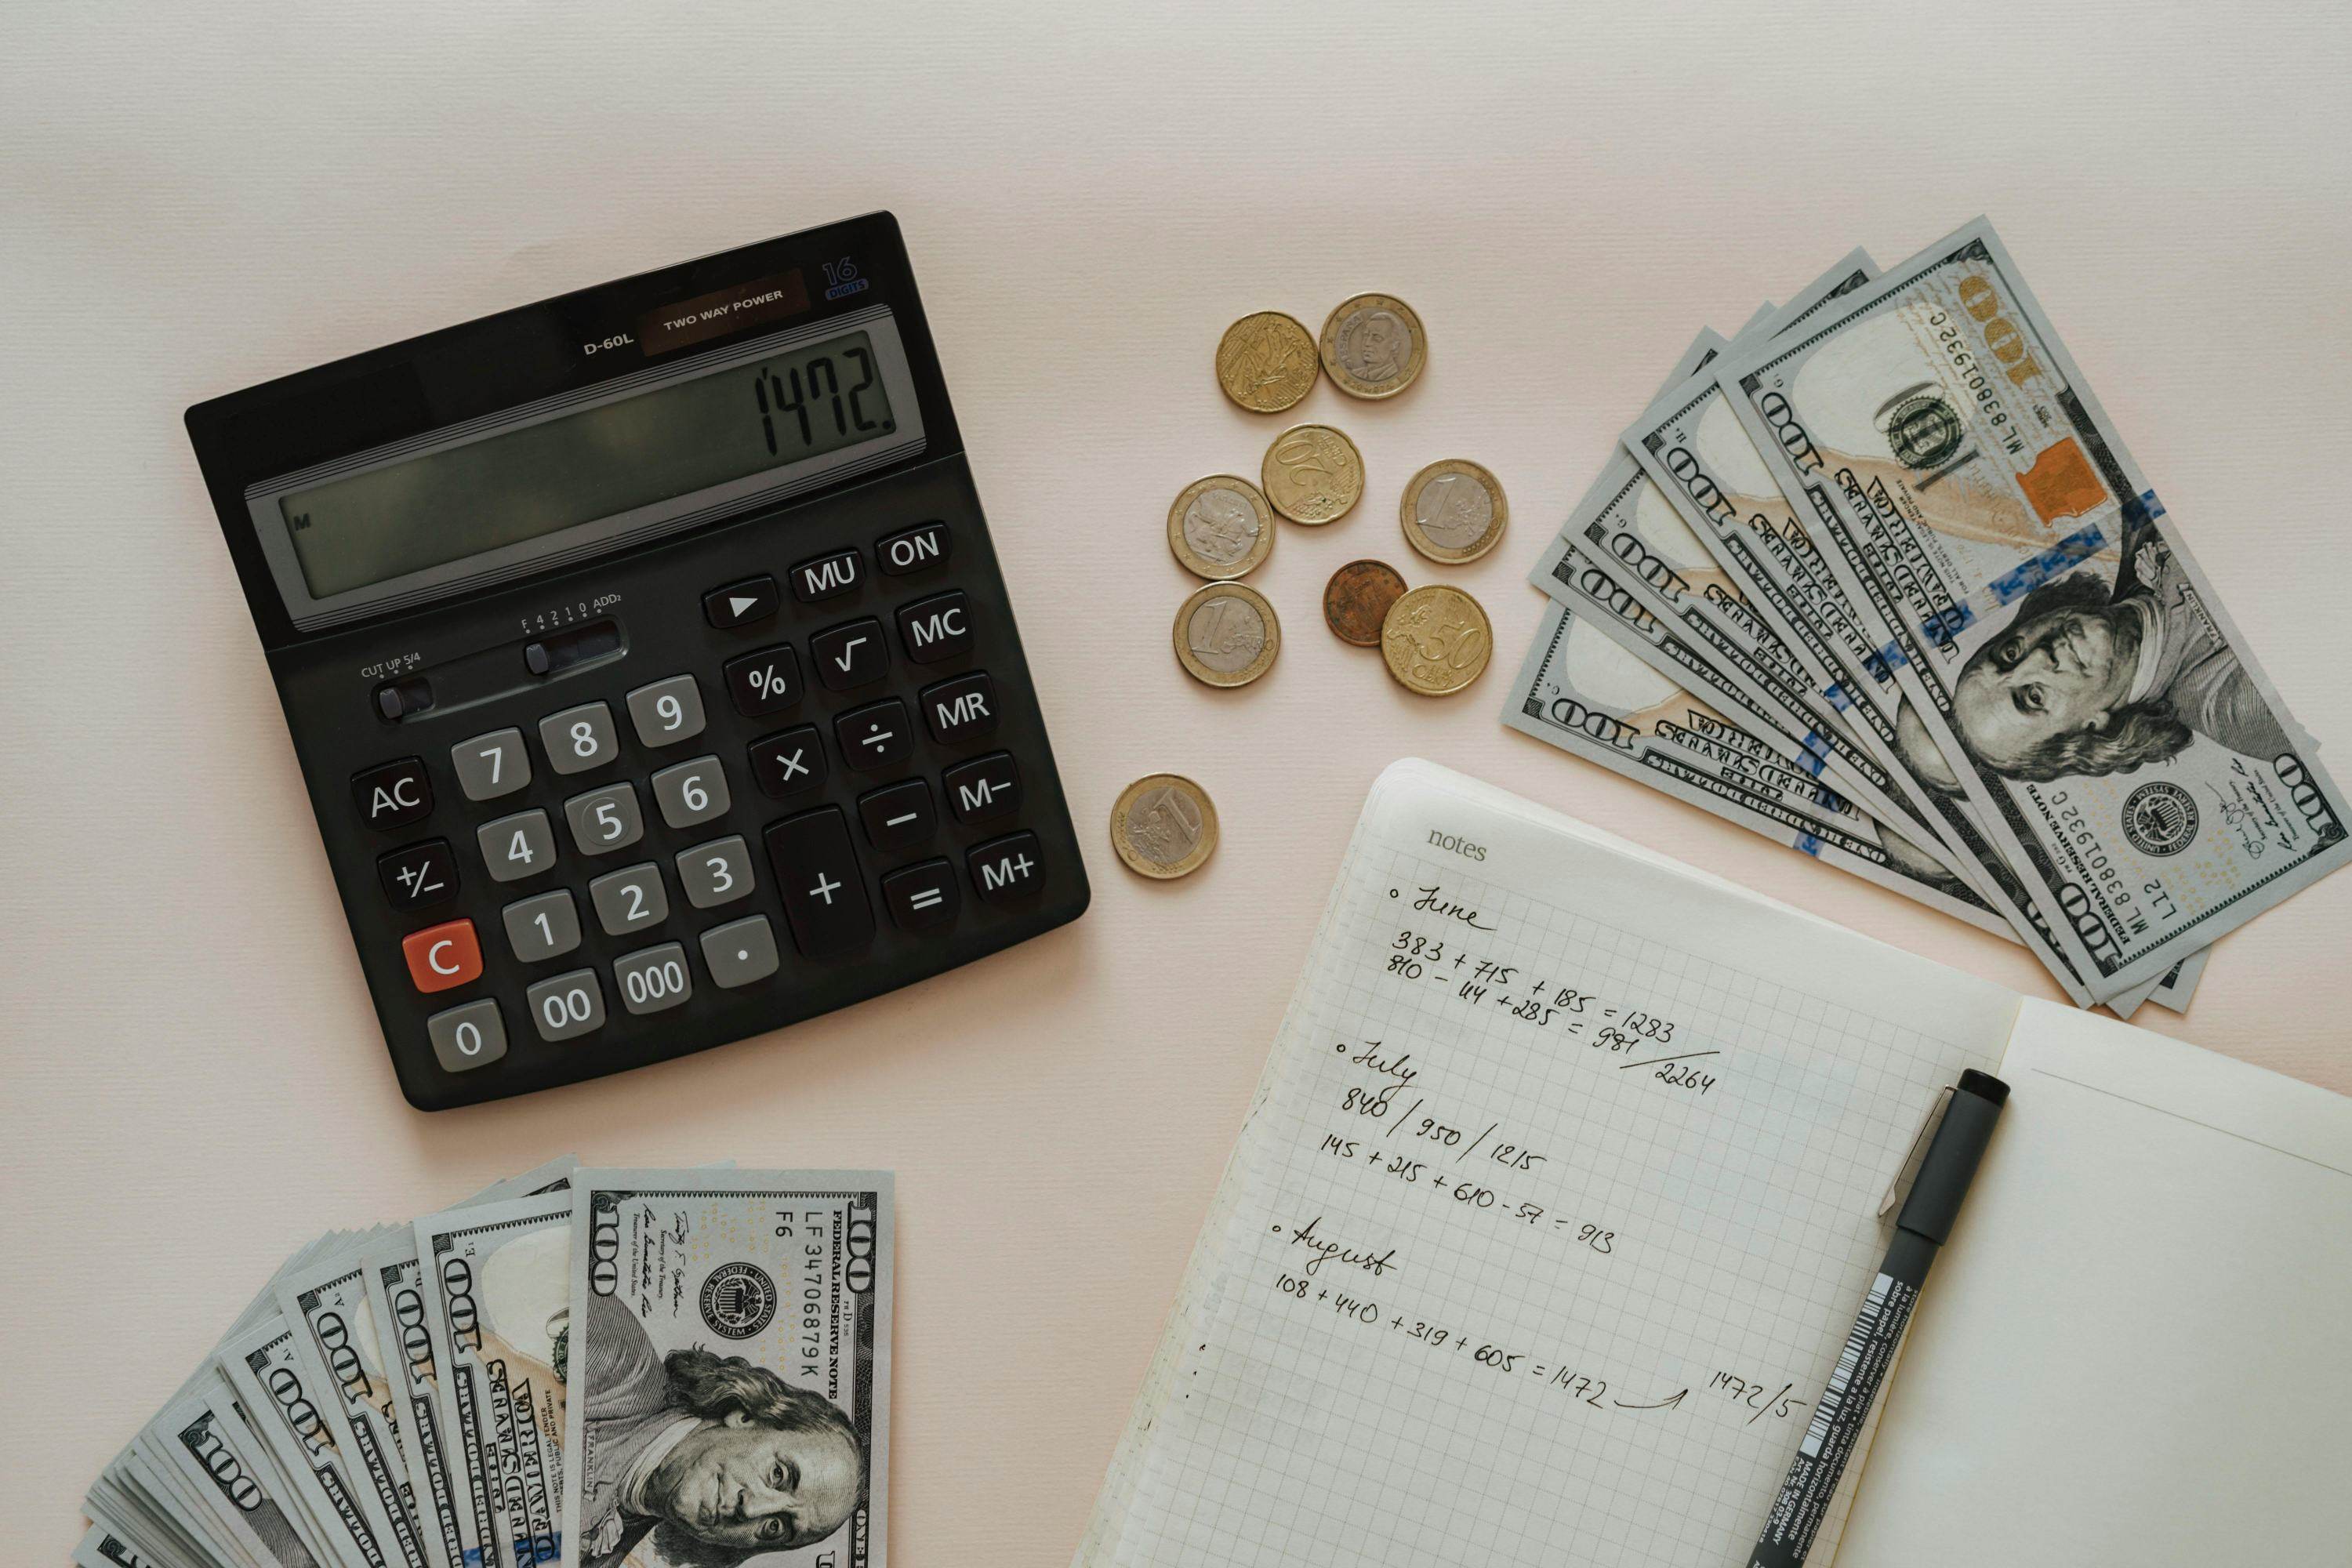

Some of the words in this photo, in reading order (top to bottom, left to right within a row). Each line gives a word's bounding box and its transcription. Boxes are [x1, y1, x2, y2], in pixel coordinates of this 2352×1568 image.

[822, 256, 857, 285] 16
[828, 280, 866, 299] DIGITS
[664, 316, 696, 330] TWO
[700, 306, 728, 320] WAY
[734, 291, 782, 310] POWER
[1928, 310, 1947, 328] C
[584, 334, 633, 354] D-60L
[1958, 275, 2044, 387] 100
[1936, 325, 2009, 427] 83801932
[1761, 391, 1824, 473] 100
[1998, 425, 2025, 455] ML
[1666, 446, 1737, 523] 100
[294, 514, 310, 530] M
[891, 532, 938, 565] ON
[1610, 532, 1692, 601] 100
[805, 557, 855, 593] MU
[521, 619, 528, 628] F
[537, 616, 543, 625] 4
[550, 611, 558, 621] 2
[565, 608, 571, 616] 1
[912, 608, 965, 646] MC
[1864, 579, 1926, 671] HUNDRED
[2185, 592, 2218, 639] FRANKLIN
[361, 664, 384, 679] CUT
[386, 659, 401, 670] UP
[403, 652, 421, 665] 5/4
[750, 665, 785, 699] %
[1920, 671, 1951, 712] ONE
[656, 695, 683, 731] 9
[937, 693, 989, 728] MR
[1551, 696, 1641, 749] 100
[570, 722, 598, 757] 8
[480, 747, 502, 784] 7
[372, 778, 419, 818] AC
[682, 776, 709, 811] 6
[2025, 782, 2055, 823] NOTE
[2050, 789, 2069, 806] C
[2273, 753, 2337, 835] 100
[596, 804, 622, 840] 5
[508, 830, 532, 864] 4
[1428, 830, 1486, 861] notes
[2049, 819, 2093, 884] RESERVE
[2060, 804, 2132, 907] 83801932
[706, 857, 733, 892] 3
[982, 854, 1033, 890] M+
[620, 885, 650, 921] 2
[1414, 887, 1497, 931] June
[2089, 883, 2131, 945] FEDERAL
[2142, 877, 2176, 920] L12
[534, 913, 554, 946] 1
[2059, 880, 2124, 964] 100
[2122, 906, 2150, 936] ML
[429, 940, 459, 975] C
[627, 961, 683, 1003] 000
[1391, 931, 1443, 965] 383
[1455, 954, 1465, 968] +
[1475, 961, 1518, 983] 715
[1534, 981, 1544, 995] +
[1555, 989, 1595, 1012] 185
[1618, 1012, 1674, 1046] 1283
[543, 989, 590, 1029] 00
[1512, 996, 1564, 1025] 285
[456, 1022, 481, 1055] 0
[1353, 1041, 1418, 1103] July
[1656, 1063, 1715, 1094] 2264
[1341, 1088, 1388, 1117] 840
[1417, 1119, 1461, 1145] 950
[1491, 1145, 1546, 1169] 1215
[1321, 1134, 1359, 1157] 145
[1370, 1152, 1382, 1164] +
[1388, 1157, 1426, 1181] 215
[1434, 1176, 1446, 1188] +
[1454, 1184, 1494, 1207] 610
[1515, 1203, 1544, 1224] 57
[1578, 1225, 1614, 1253] 913
[775, 1211, 793, 1237] F6
[804, 1211, 822, 1236] LF
[591, 1205, 619, 1297] 100
[831, 1210, 841, 1279] FEDERAL
[845, 1200, 872, 1294] 100
[1292, 1218, 1396, 1276] August
[443, 1258, 483, 1350] 100
[802, 1244, 822, 1358] 34706879
[1887, 1280, 1905, 1308] sobre
[1900, 1293, 1910, 1303] la
[394, 1289, 440, 1381] 100
[829, 1282, 840, 1354] RESERVE
[1872, 1308, 1893, 1338] papel,
[1883, 1303, 1905, 1341] lumière,
[317, 1311, 373, 1401] 100
[1276, 1274, 1308, 1298] 108
[1319, 1290, 1327, 1300] +
[1336, 1294, 1377, 1322] 440
[1392, 1317, 1402, 1329] +
[1407, 1323, 1448, 1345] 319
[1457, 1338, 1466, 1350] +
[1475, 1345, 1524, 1371] 605
[1552, 1367, 1606, 1407] 1472
[801, 1366, 818, 1377] K
[828, 1357, 838, 1399] NOTE
[1853, 1339, 1879, 1386] resistente
[1865, 1342, 1888, 1385] conserver
[269, 1367, 336, 1453] 100
[1836, 1405, 1851, 1425] luz,
[1845, 1395, 1856, 1405] la
[1852, 1394, 1866, 1414] plat
[539, 1406, 551, 1436] TENDER
[1840, 1422, 1854, 1445] tinta
[544, 1439, 556, 1464] LEGAL
[1820, 1424, 1843, 1460] guarda
[188, 1432, 262, 1514] 100
[586, 1435, 594, 1488] FRANKLIN
[1794, 1457, 1806, 1475] Art.
[1795, 1461, 1813, 1488] MADE
[1816, 1445, 1845, 1501] documento,
[550, 1475, 560, 1493] NOTE
[1788, 1475, 1798, 1488] Nr.
[1791, 1488, 1801, 1499] IN
[554, 1495, 563, 1512] THIS
[1772, 1504, 1785, 1525] 03-9
[1787, 1461, 1828, 1541] horizontalmente
[1771, 1499, 1796, 1545] GERMANY
[1790, 1501, 1820, 1559] permanente
